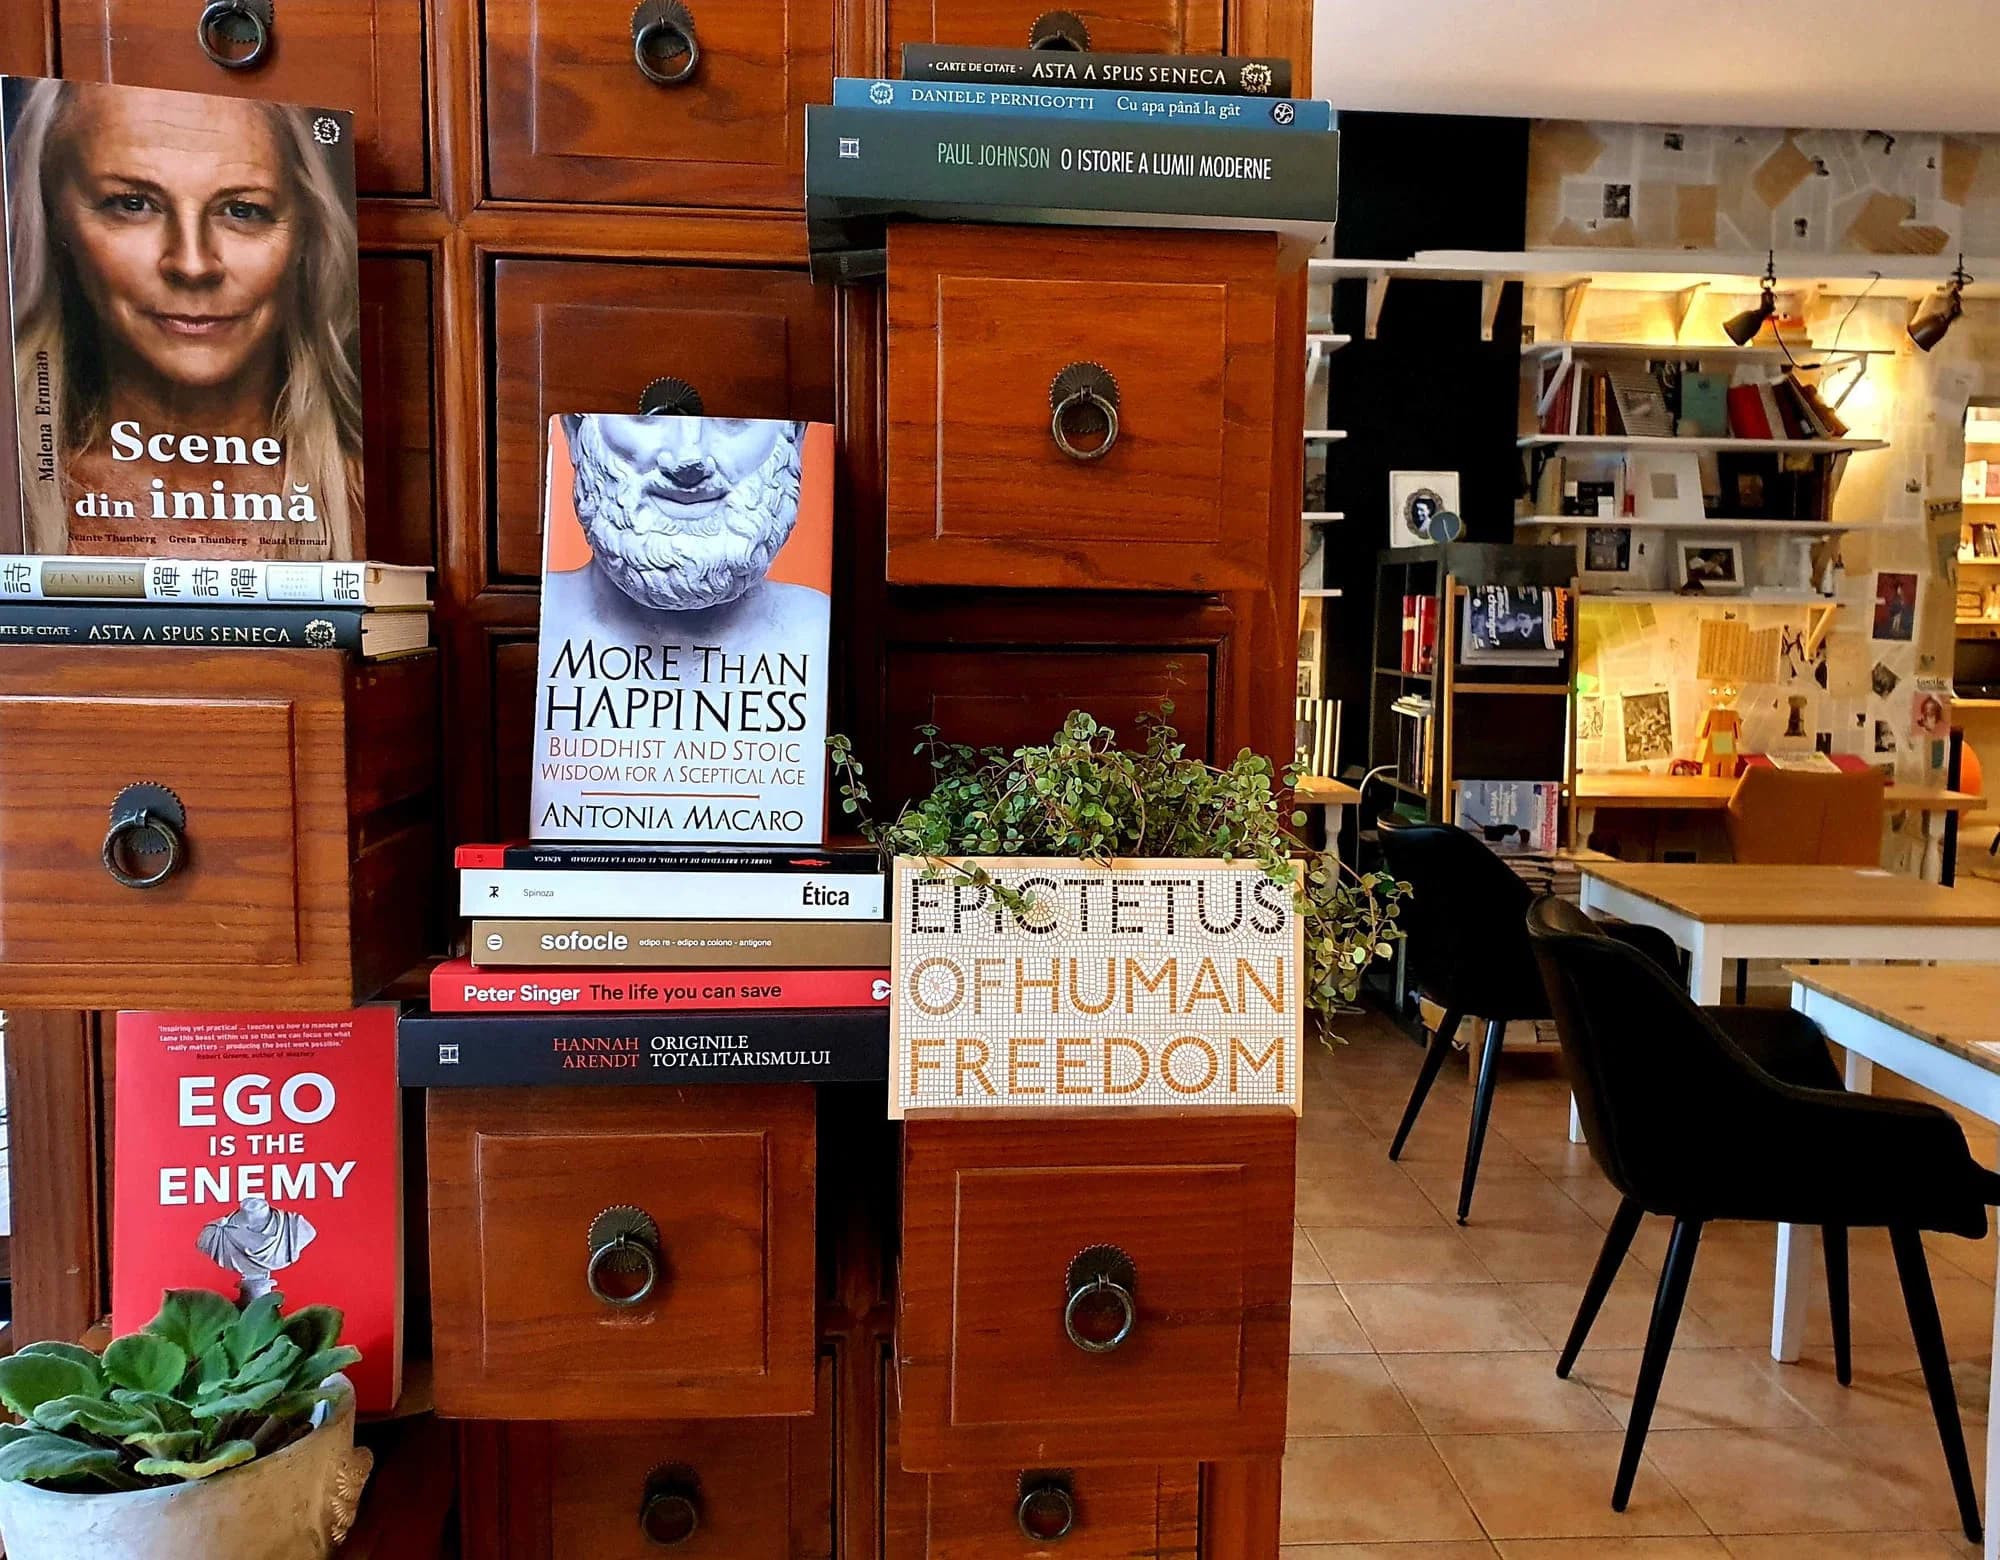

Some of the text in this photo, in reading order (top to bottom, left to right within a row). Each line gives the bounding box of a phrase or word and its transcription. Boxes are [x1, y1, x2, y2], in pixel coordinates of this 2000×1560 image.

[935, 61, 1227, 86] CARTE DE CITATE ASTA A SPUS SENECA
[911, 88, 1241, 120] DANIELE PERNIGOTTI Cu apa până la gât
[937, 142, 1272, 181] PAUL JOHNSON O ISTORIE A LUMII MODERNE
[35, 350, 55, 482] Malena Ernman
[109, 420, 281, 466] Scene
[75, 479, 318, 523] din inimă
[68, 533, 157, 545] Svante Thunberg
[168, 535, 248, 546] Greta Thunberg
[259, 537, 328, 546] Beata Ernman
[49, 573, 137, 585] ZEN POEMS
[20, 626, 35, 635] DE
[36, 626, 71, 636] CITATE
[88, 625, 136, 641] ASTA
[142, 626, 156, 641] A
[162, 626, 204, 641] SPUS
[211, 627, 291, 643] SENECA
[549, 638, 810, 687] MORE THAN
[544, 685, 808, 733] HAPPINESS
[549, 736, 801, 763] BUDDHIST AND STOIC
[541, 763, 806, 786] WISDOM FOR A SCEPTICAL AGE
[540, 801, 804, 832] ANTONIA MACARO
[523, 888, 555, 898] Spinoza
[802, 880, 850, 906] Ética
[911, 877, 1287, 935] EPICTETUS
[540, 930, 628, 951] sofocle
[639, 939, 661, 947] edipo
[677, 939, 699, 947] edipo
[707, 938, 733, 946] colono
[739, 938, 772, 947] antigone
[463, 983, 782, 1005] Peter Singer The life you can save
[206, 1024, 238, 1033] practical
[225, 1043, 260, 1051] producing
[553, 1037, 640, 1051] HANNAH
[650, 1035, 749, 1050] ORIGINILE
[562, 1054, 640, 1069] ARENDT
[650, 1051, 831, 1068] TOTALITARISMULUI
[910, 1035, 1285, 1097] FREEDOM
[178, 1072, 336, 1127] EGO
[209, 1133, 305, 1157] IS THE
[159, 1160, 357, 1206] ENEMY
